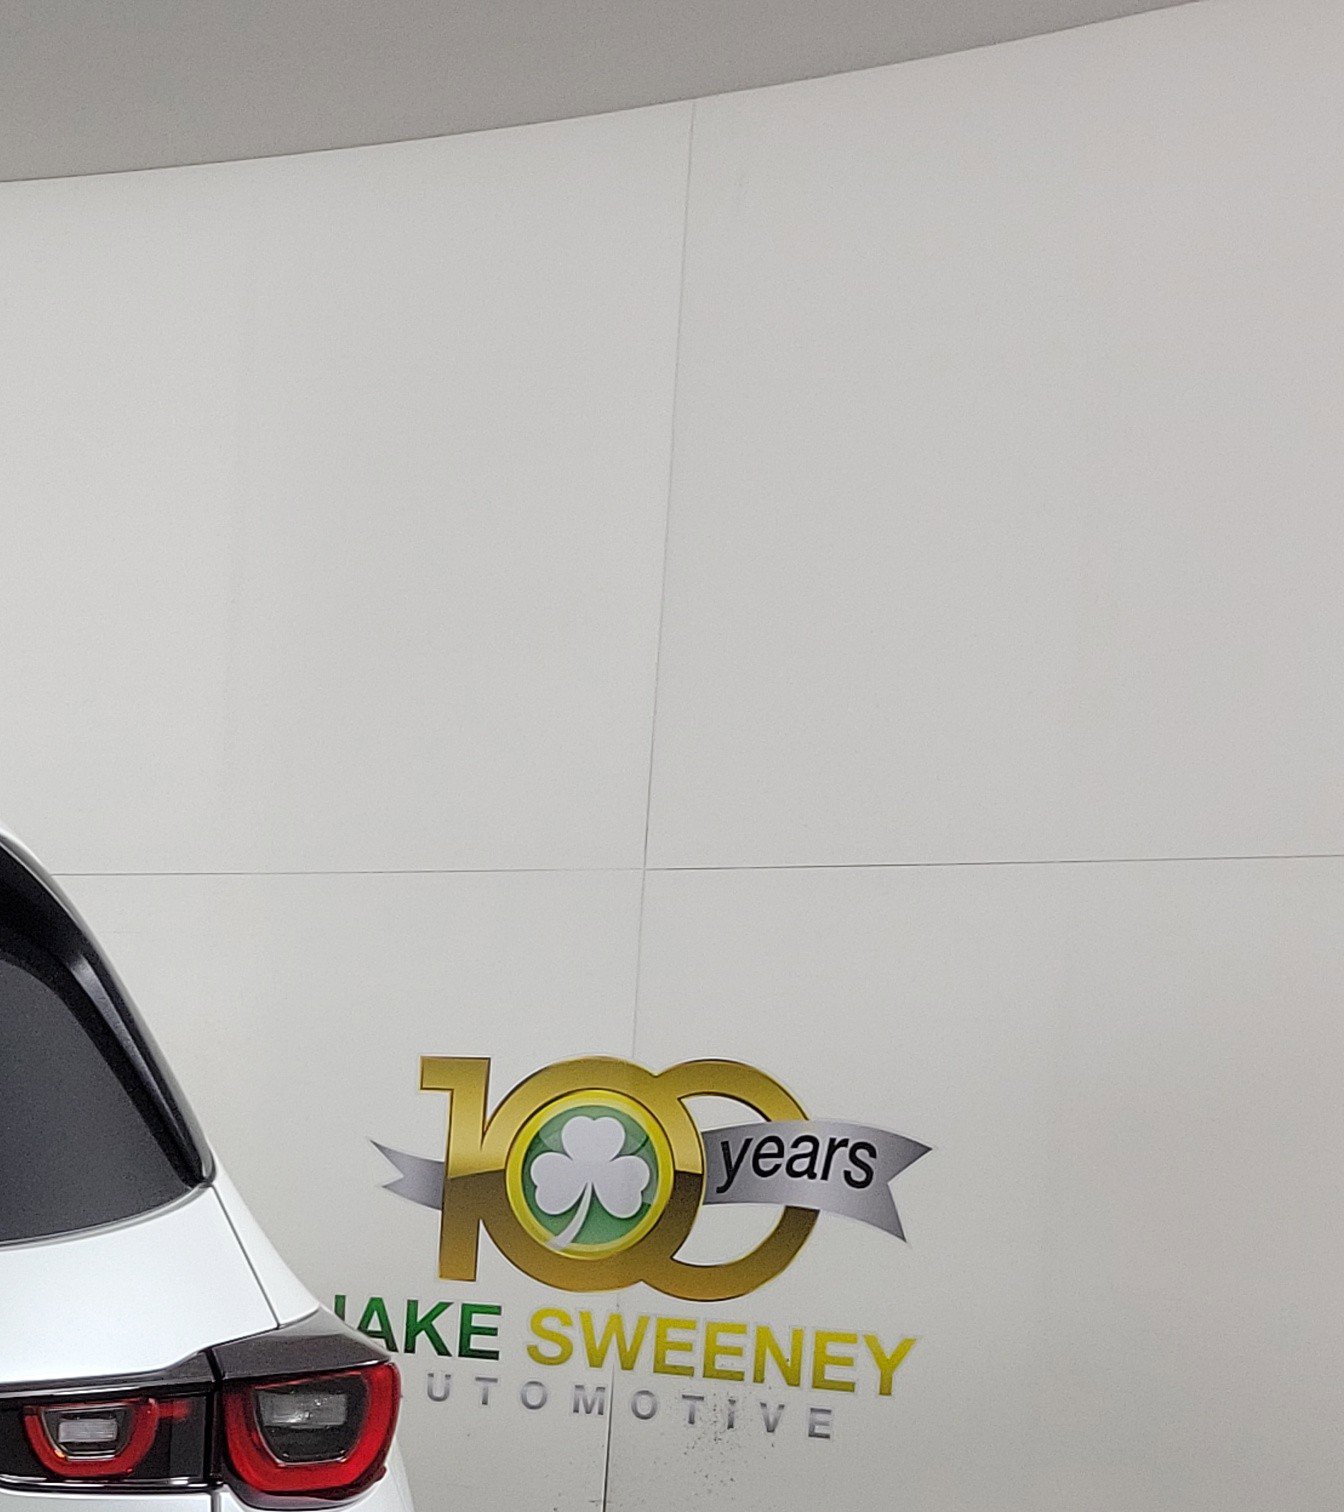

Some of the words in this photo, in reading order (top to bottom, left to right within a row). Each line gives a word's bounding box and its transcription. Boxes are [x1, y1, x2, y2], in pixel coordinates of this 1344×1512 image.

[419, 1055, 821, 1302] 100
[715, 1134, 878, 1194] years
[525, 1307, 916, 1397] SWEENEY
